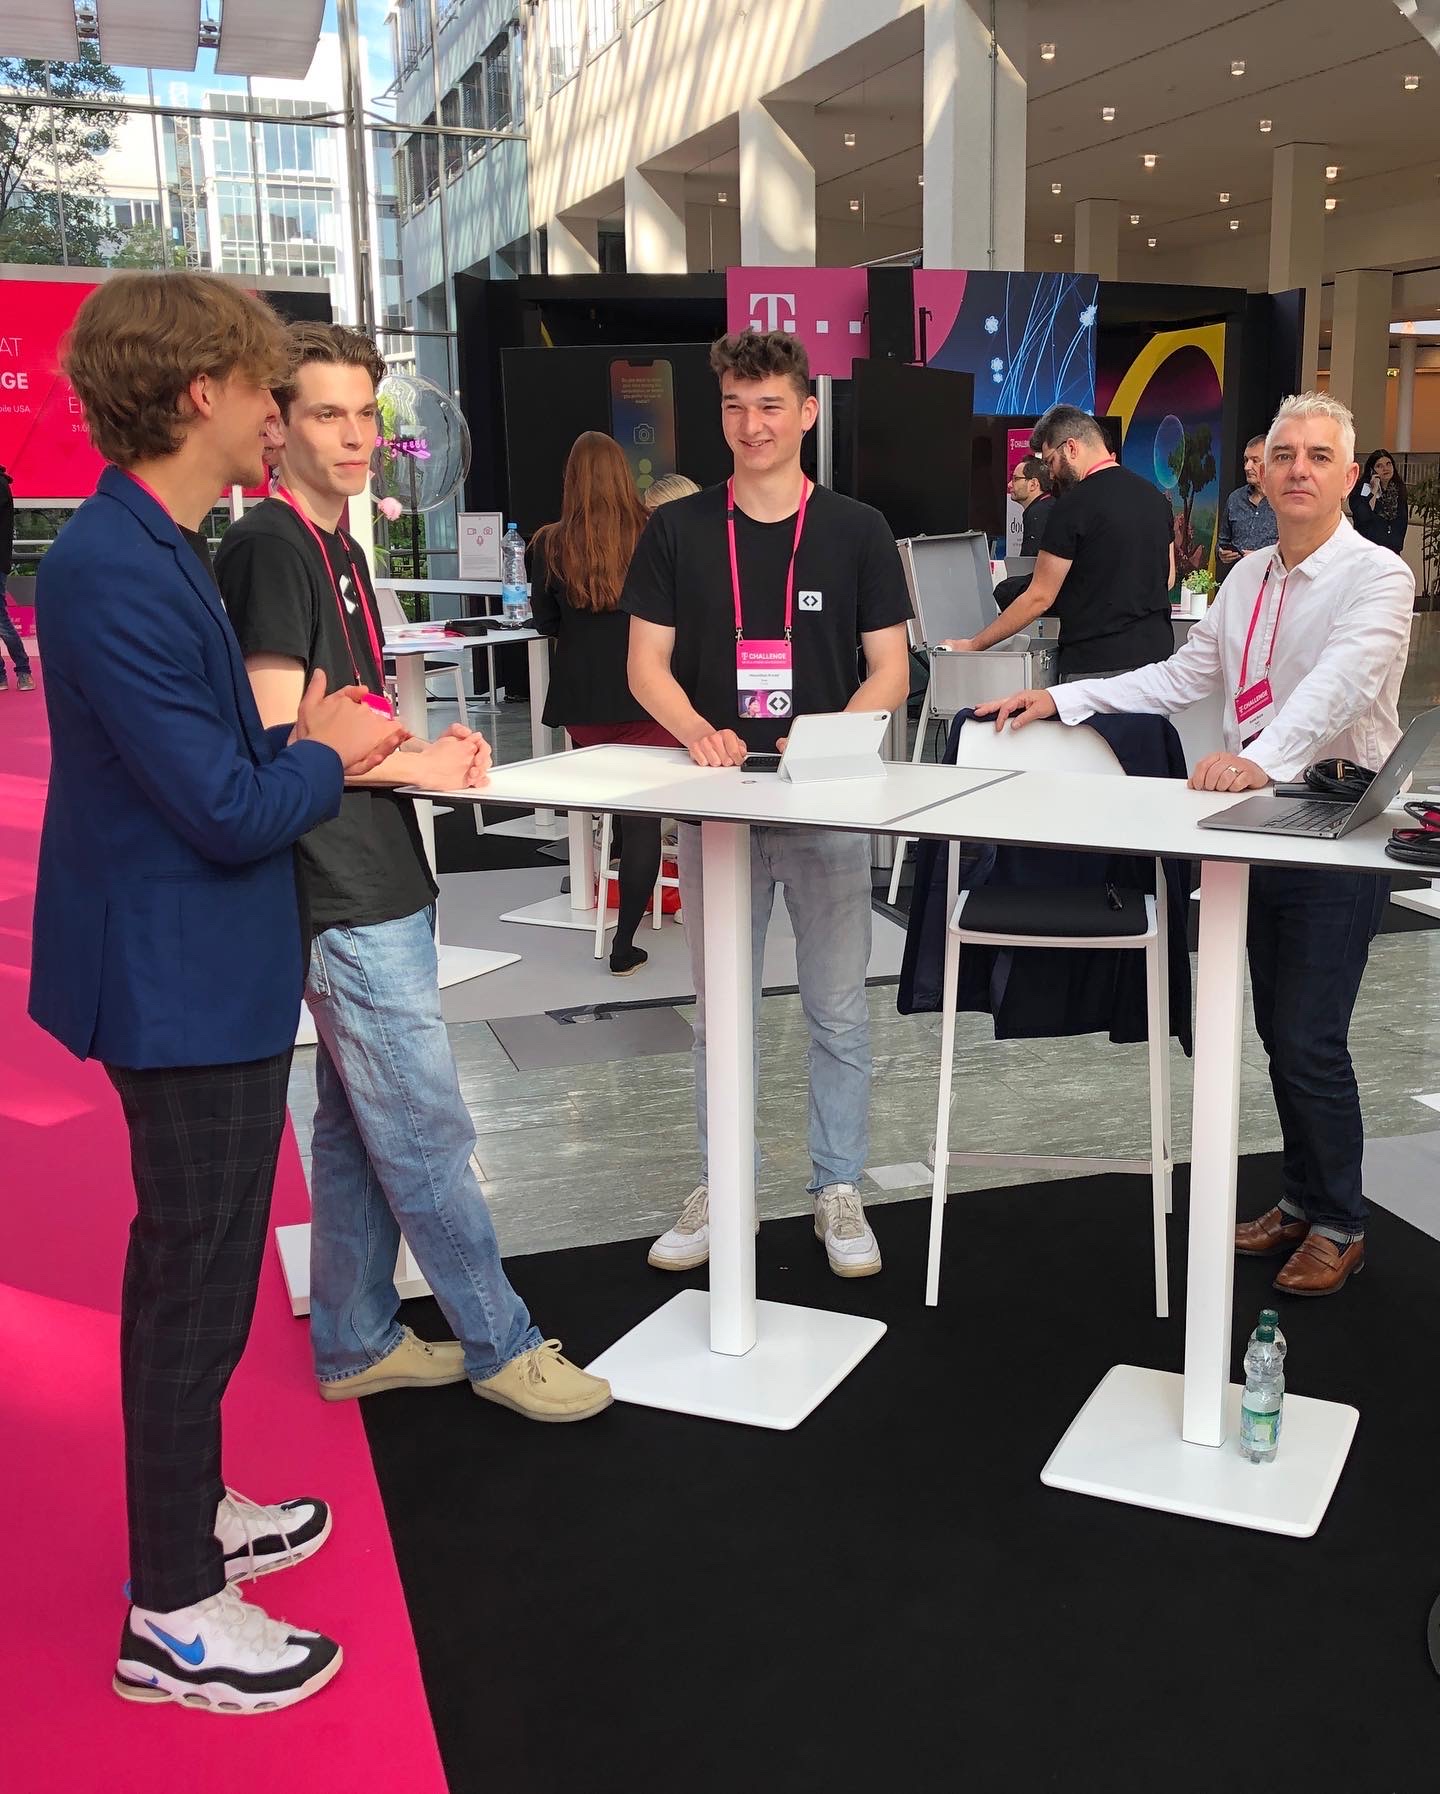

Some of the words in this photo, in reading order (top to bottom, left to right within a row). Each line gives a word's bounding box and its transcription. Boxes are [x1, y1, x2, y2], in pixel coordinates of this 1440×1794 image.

[750, 293, 796, 333] T
[0, 337, 22, 356] AT
[0, 372, 29, 389] GE
[1244, 690, 1268, 710] CHALLENGE
